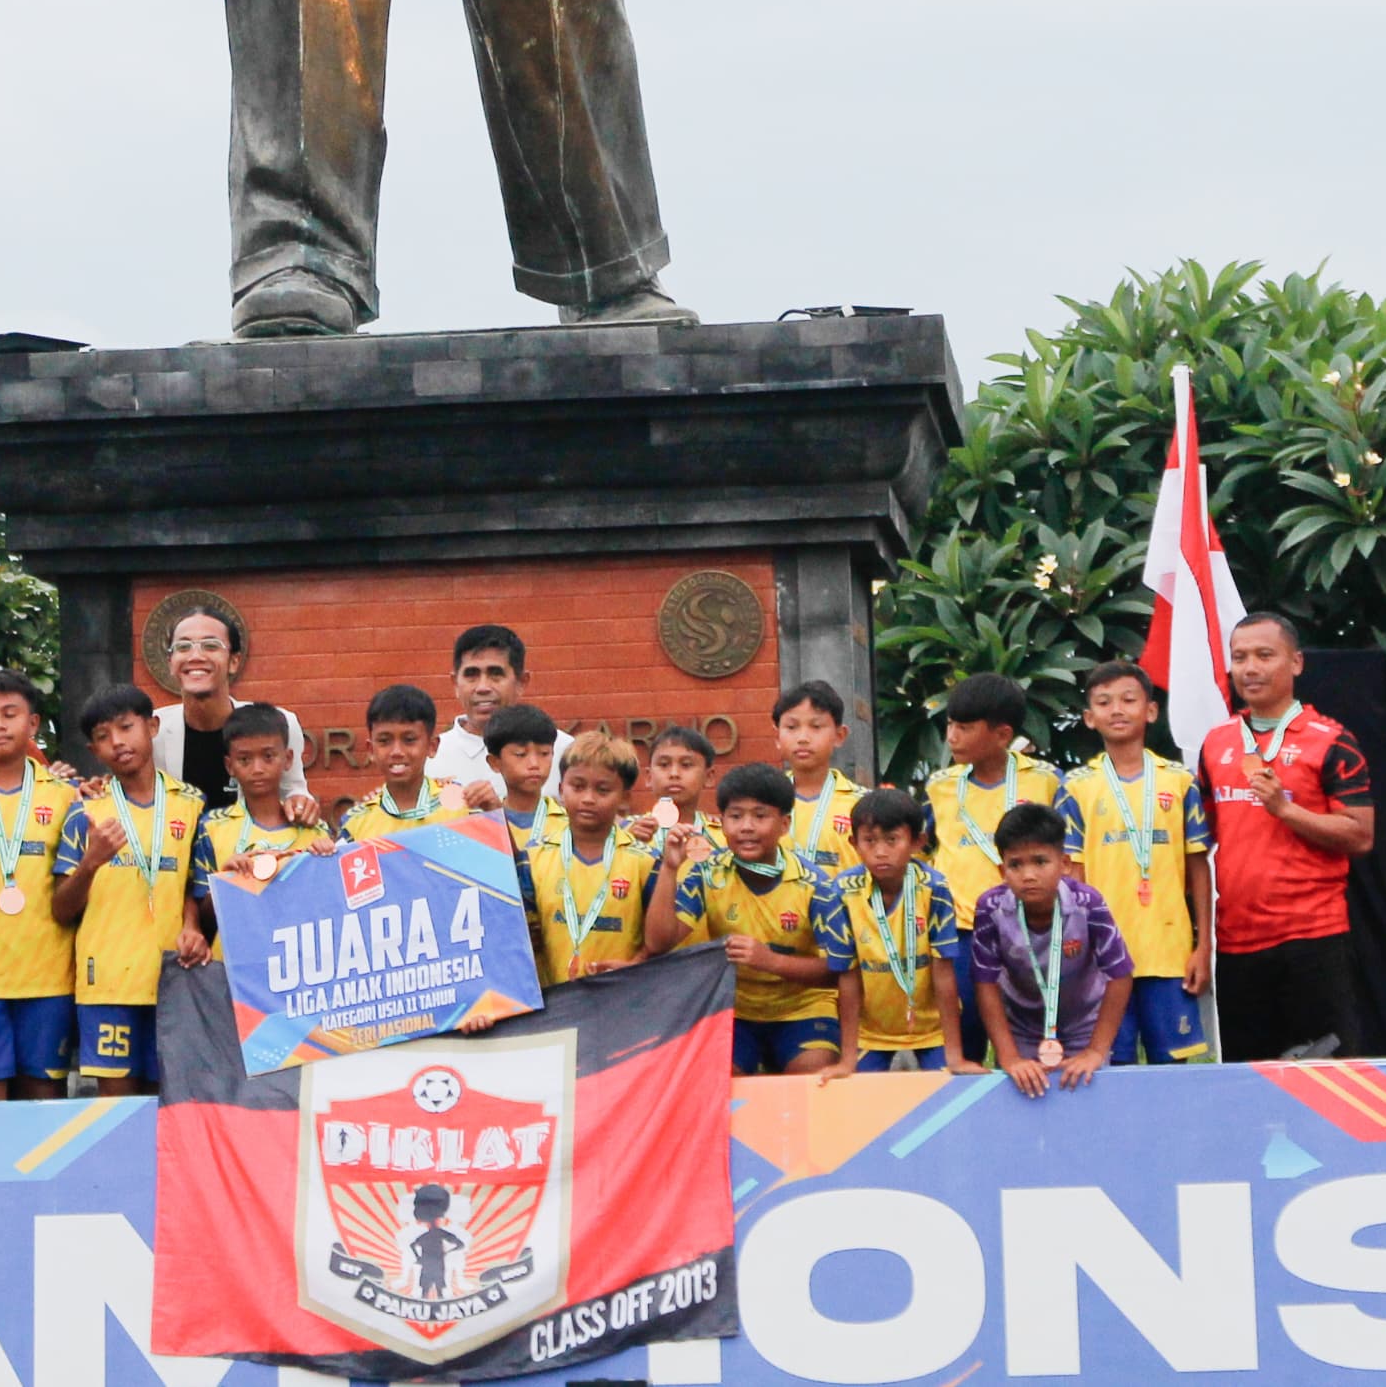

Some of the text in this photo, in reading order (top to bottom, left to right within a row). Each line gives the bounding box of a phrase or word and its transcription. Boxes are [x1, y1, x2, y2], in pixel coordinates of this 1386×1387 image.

[268, 886, 485, 994] JUARA 4
[286, 954, 483, 1019] LIGA ANAK INDONESIA
[322, 1006, 377, 1032] KATEGORI
[377, 999, 405, 1019] USIA
[419, 988, 456, 1010] TAHUN
[97, 1023, 130, 1057] 25
[350, 1013, 436, 1045] SERI NASIONAL
[322, 1120, 551, 1174] DIKLAT
[374, 1292, 489, 1320] PAKU JAYA
[530, 1259, 717, 1363] CLASS OFF 2013
